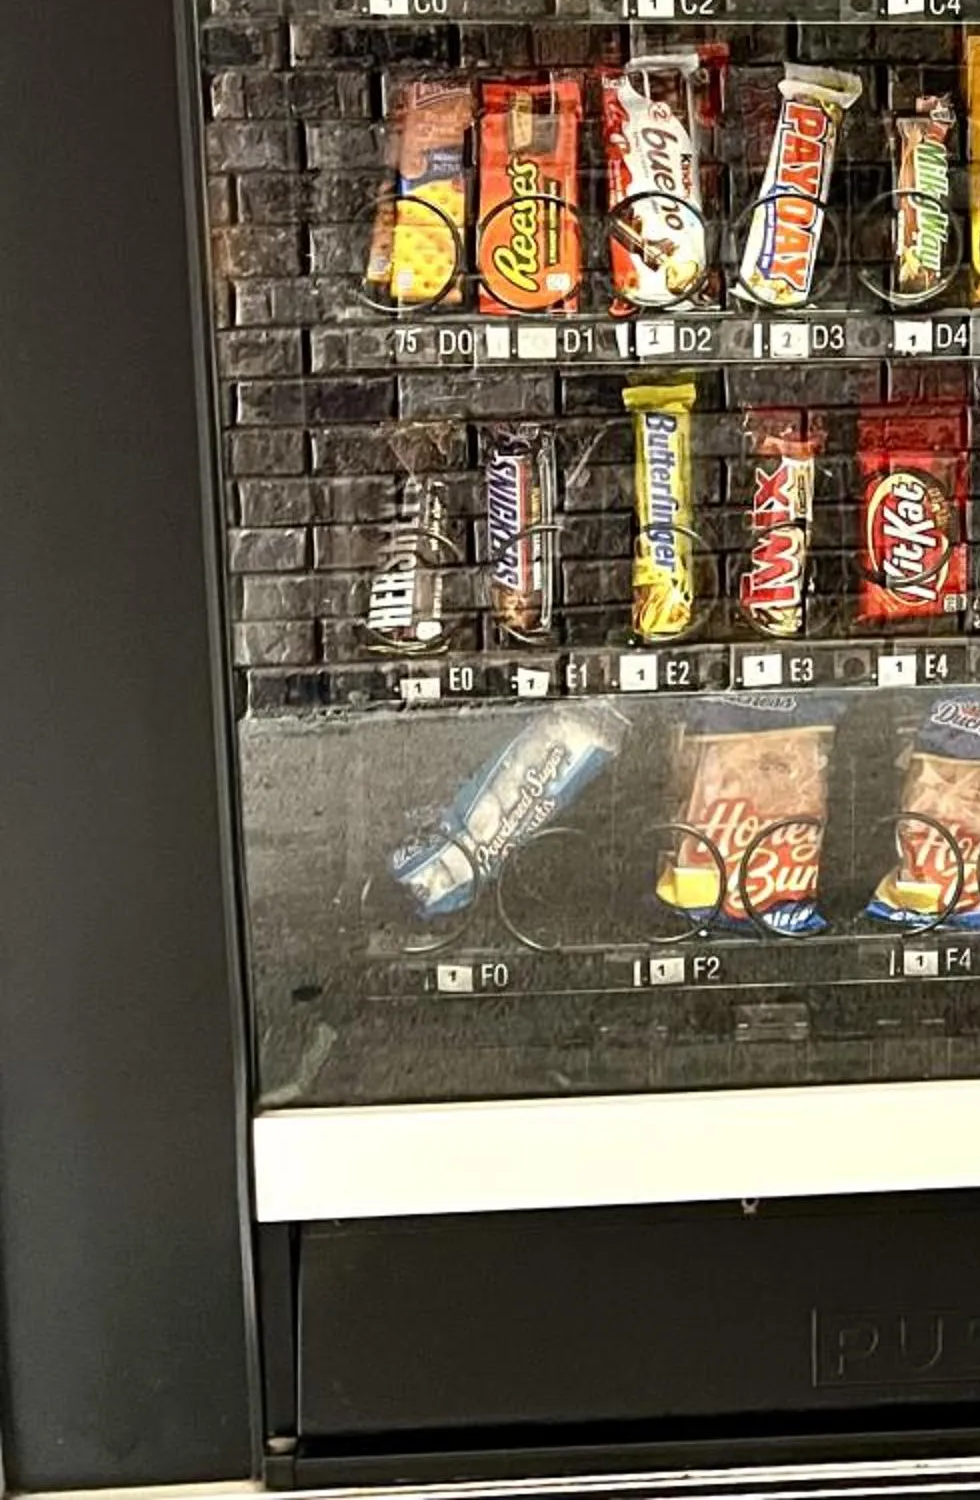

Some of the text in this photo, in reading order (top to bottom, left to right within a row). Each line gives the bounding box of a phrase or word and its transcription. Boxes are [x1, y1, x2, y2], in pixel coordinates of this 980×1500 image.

[492, 156, 541, 293] Reese's
[439, 328, 473, 355] D0
[563, 328, 594, 352] D1
[679, 327, 713, 352] D2
[812, 324, 845, 349] D3
[936, 323, 968, 348] D4
[645, 411, 677, 574] Butterfinger
[488, 454, 523, 591] SNICKERS
[448, 665, 474, 691] E0
[565, 663, 588, 688] E1
[665, 660, 690, 686] E2
[789, 657, 814, 682] E3
[924, 653, 949, 679] E4
[727, 847, 819, 910] Bun
[693, 957, 721, 982] F2
[945, 947, 972, 971] F4
[480, 963, 509, 989] F0
